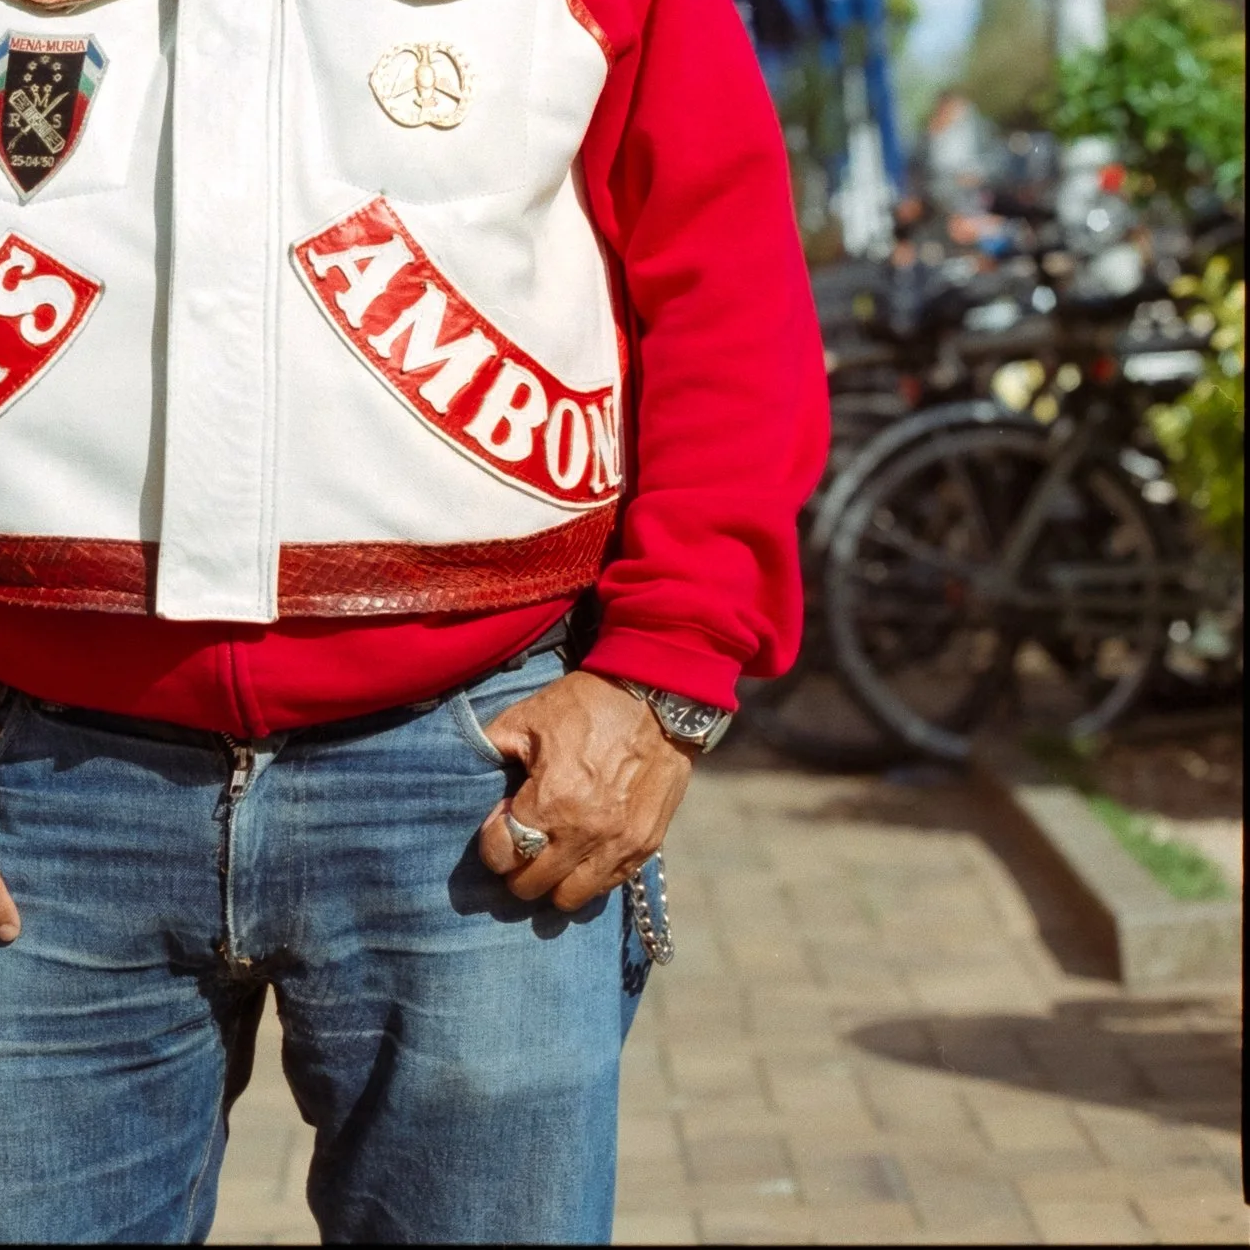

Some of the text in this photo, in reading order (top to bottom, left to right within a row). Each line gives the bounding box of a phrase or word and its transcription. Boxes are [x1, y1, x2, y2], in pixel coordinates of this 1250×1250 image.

[10, 37, 86, 51] MENA-MURIA
[8, 113, 21, 128] R
[52, 113, 62, 129] S
[306, 234, 622, 494] AMBON
